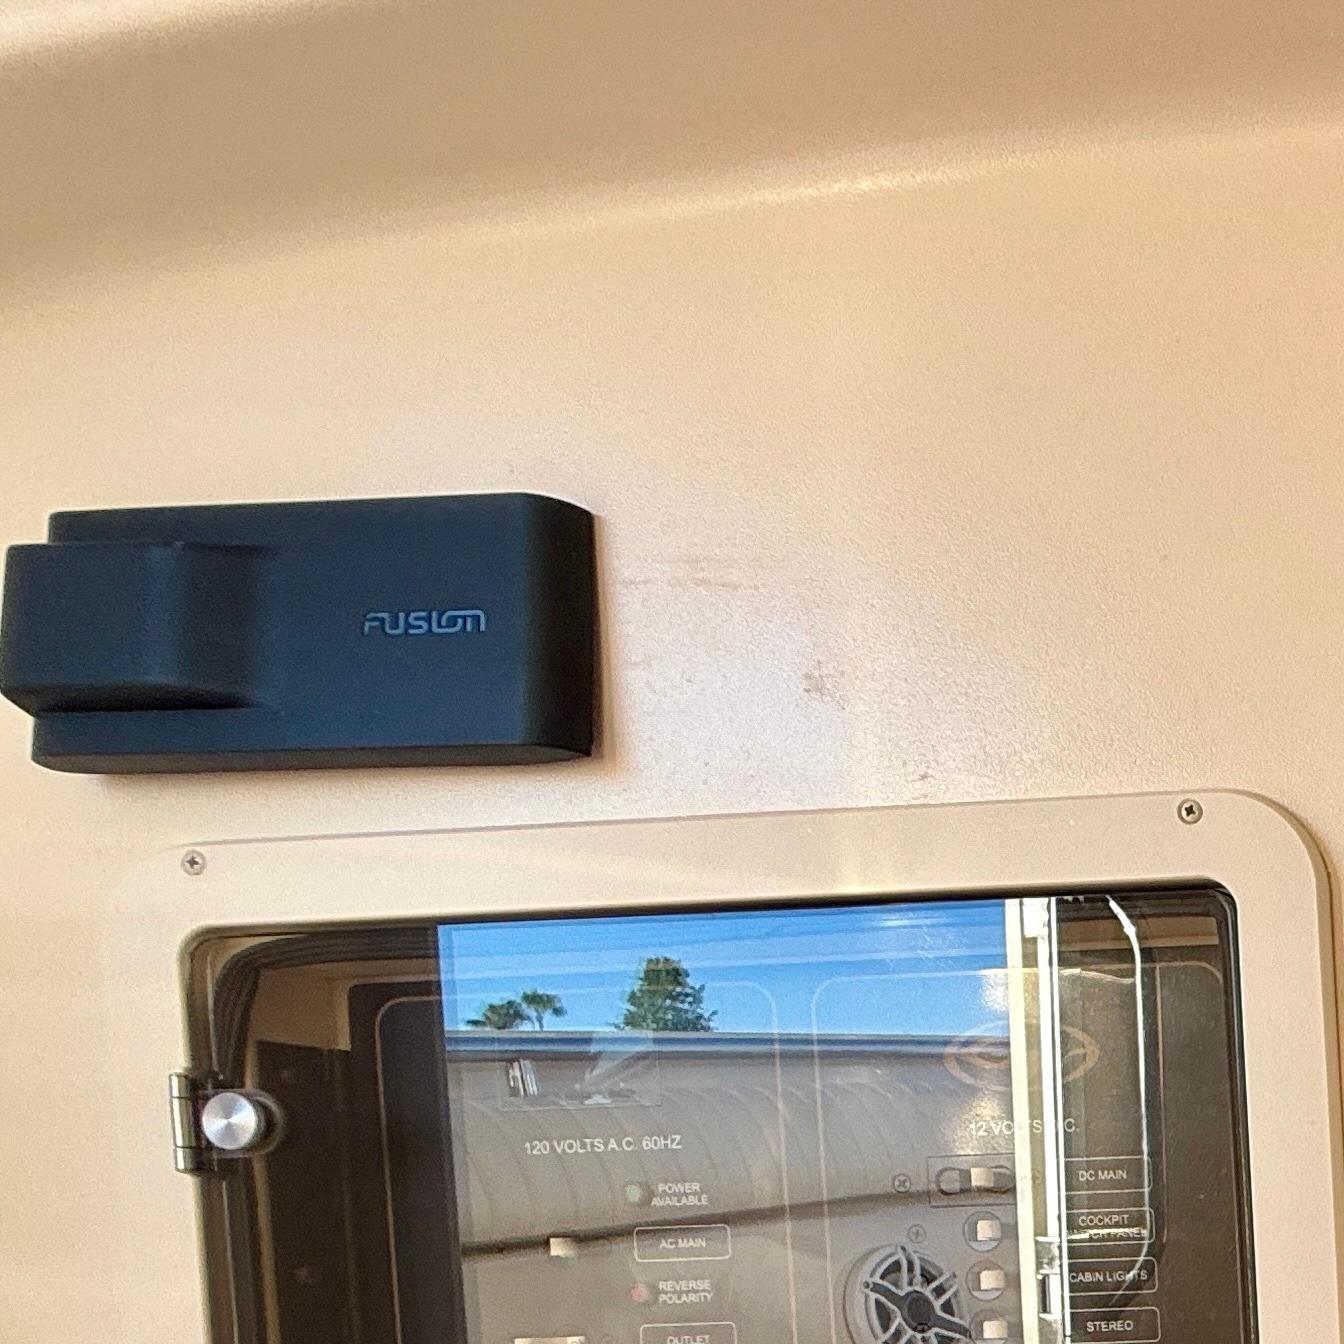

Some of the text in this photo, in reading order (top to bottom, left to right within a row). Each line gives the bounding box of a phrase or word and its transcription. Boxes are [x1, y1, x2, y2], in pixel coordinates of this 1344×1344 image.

[969, 1122, 987, 1136] 12
[524, 1141, 549, 1155] 120
[553, 1138, 605, 1154] VOLTS
[642, 1135, 682, 1150] 60HZ
[1078, 1168, 1127, 1182] DC MAIN
[658, 1182, 701, 1194] POWER
[651, 1194, 709, 1206] AVAILABLE
[1078, 1214, 1129, 1227] COCKPIT
[659, 1237, 706, 1249] AC MAIN
[1069, 1271, 1103, 1283] CABIN
[658, 1279, 711, 1292] REVERSE
[658, 1291, 714, 1305] POLARITY
[1086, 1320, 1134, 1332] STEREO
